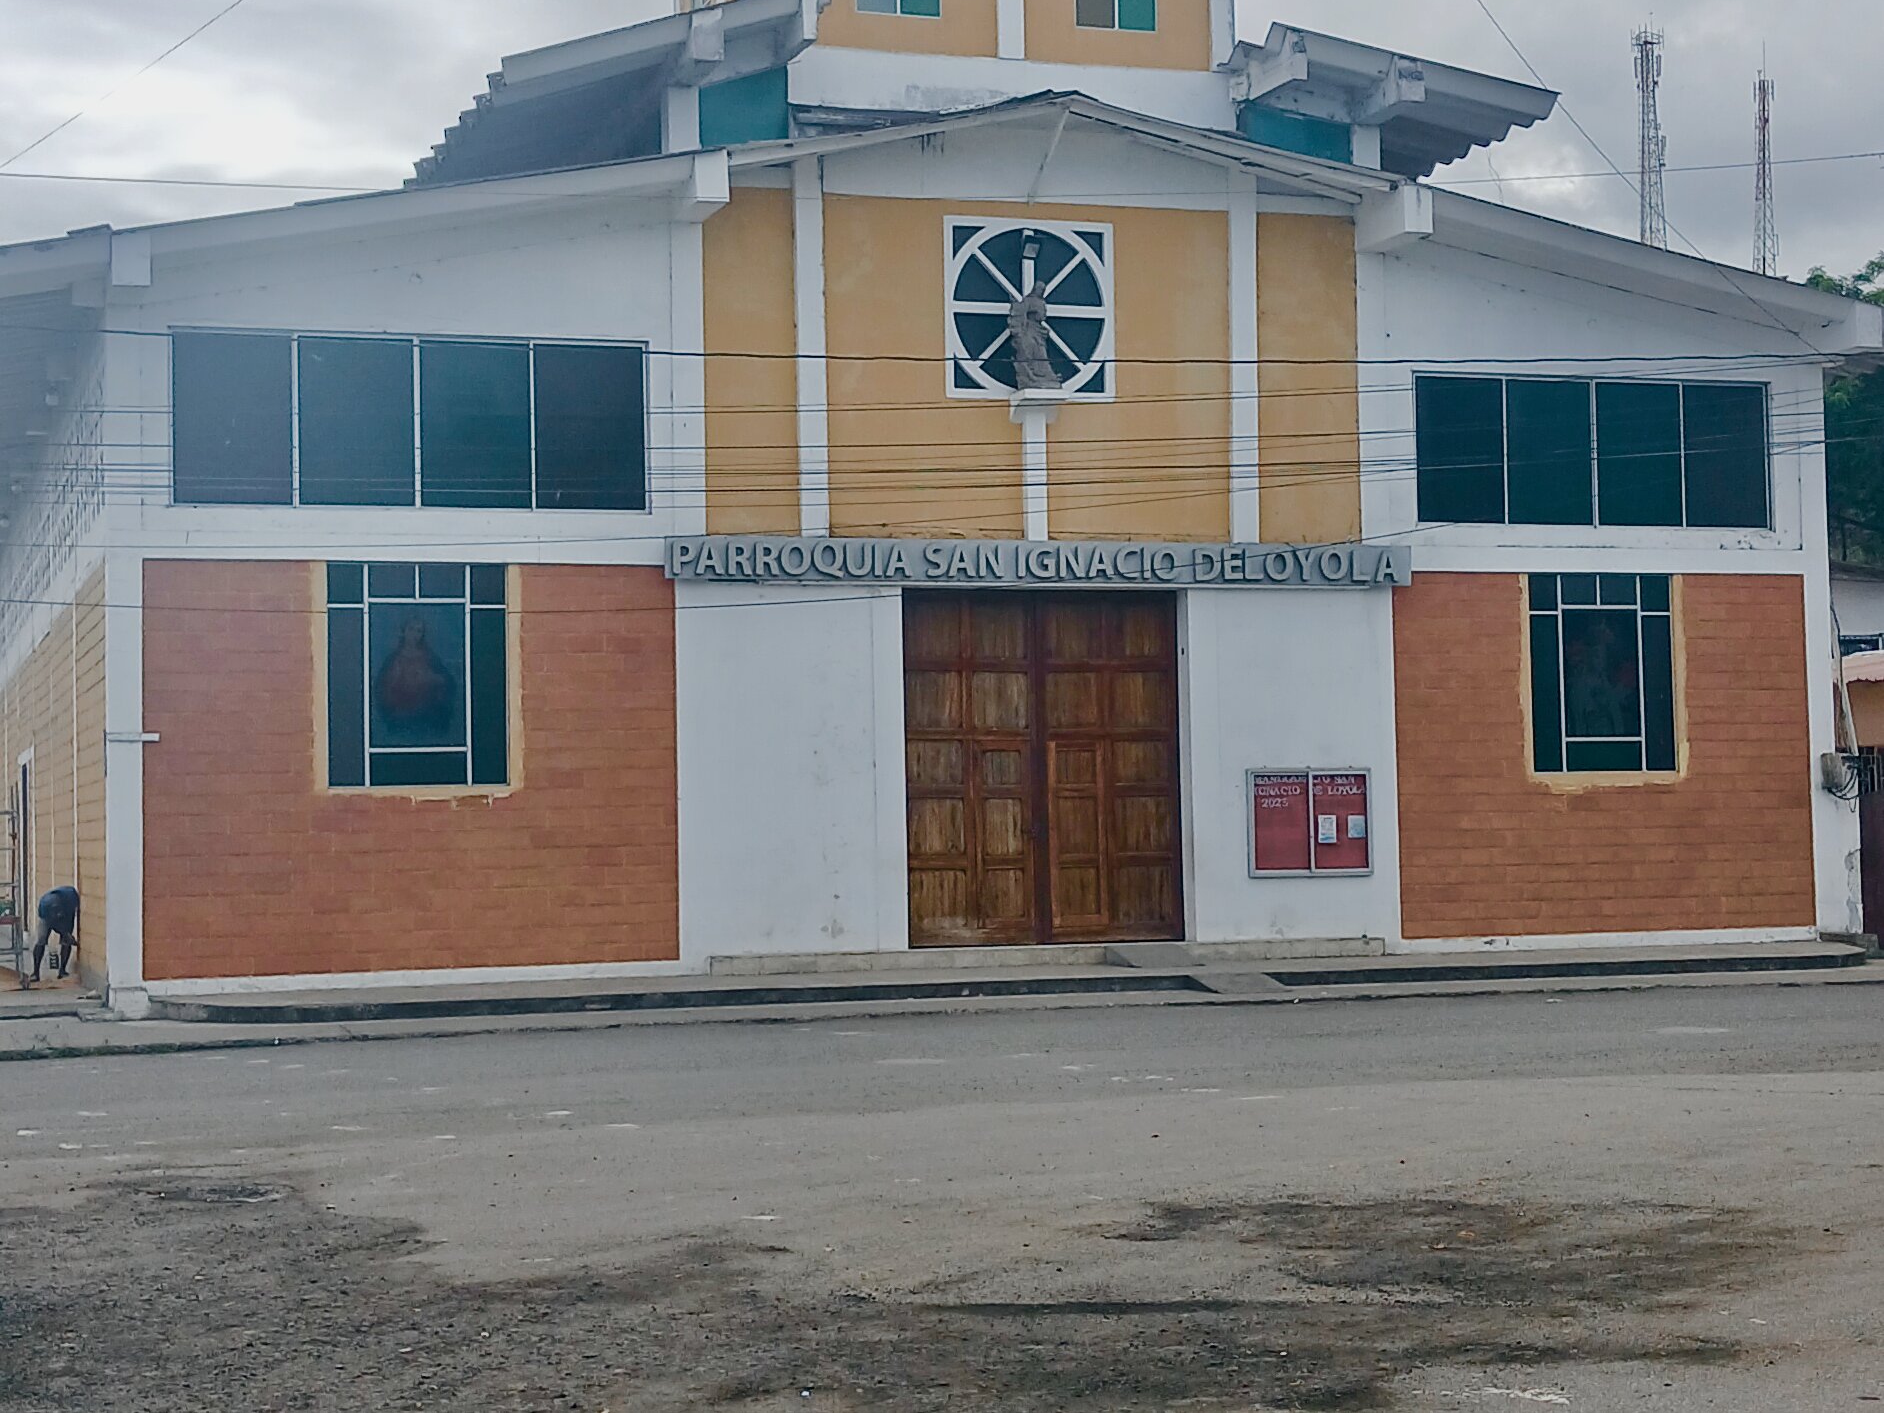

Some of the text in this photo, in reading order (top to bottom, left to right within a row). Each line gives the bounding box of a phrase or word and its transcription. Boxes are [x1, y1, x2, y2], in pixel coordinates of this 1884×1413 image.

[670, 538, 912, 578] PARROQUIA
[924, 543, 1005, 578] SAN
[1015, 544, 1178, 580] IGNACIO
